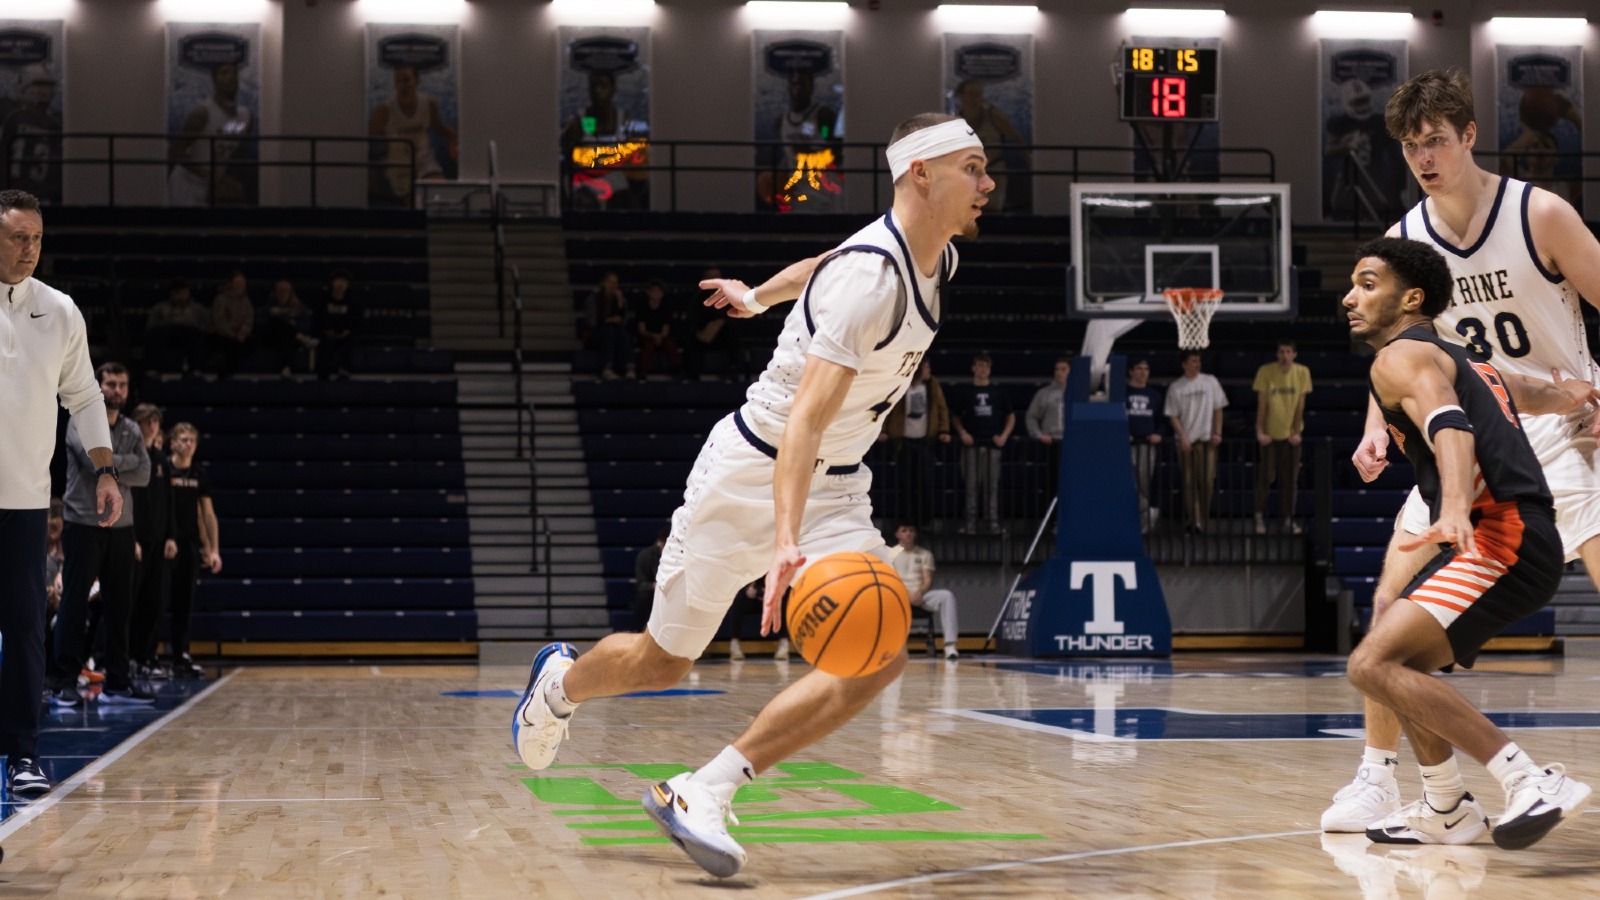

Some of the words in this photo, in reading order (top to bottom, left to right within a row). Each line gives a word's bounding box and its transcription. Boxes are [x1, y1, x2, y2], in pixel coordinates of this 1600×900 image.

[1151, 77, 1186, 118] 18
[1455, 311, 1531, 362] 30
[1069, 560, 1138, 635] T
[1053, 634, 1154, 651] THUNDER
